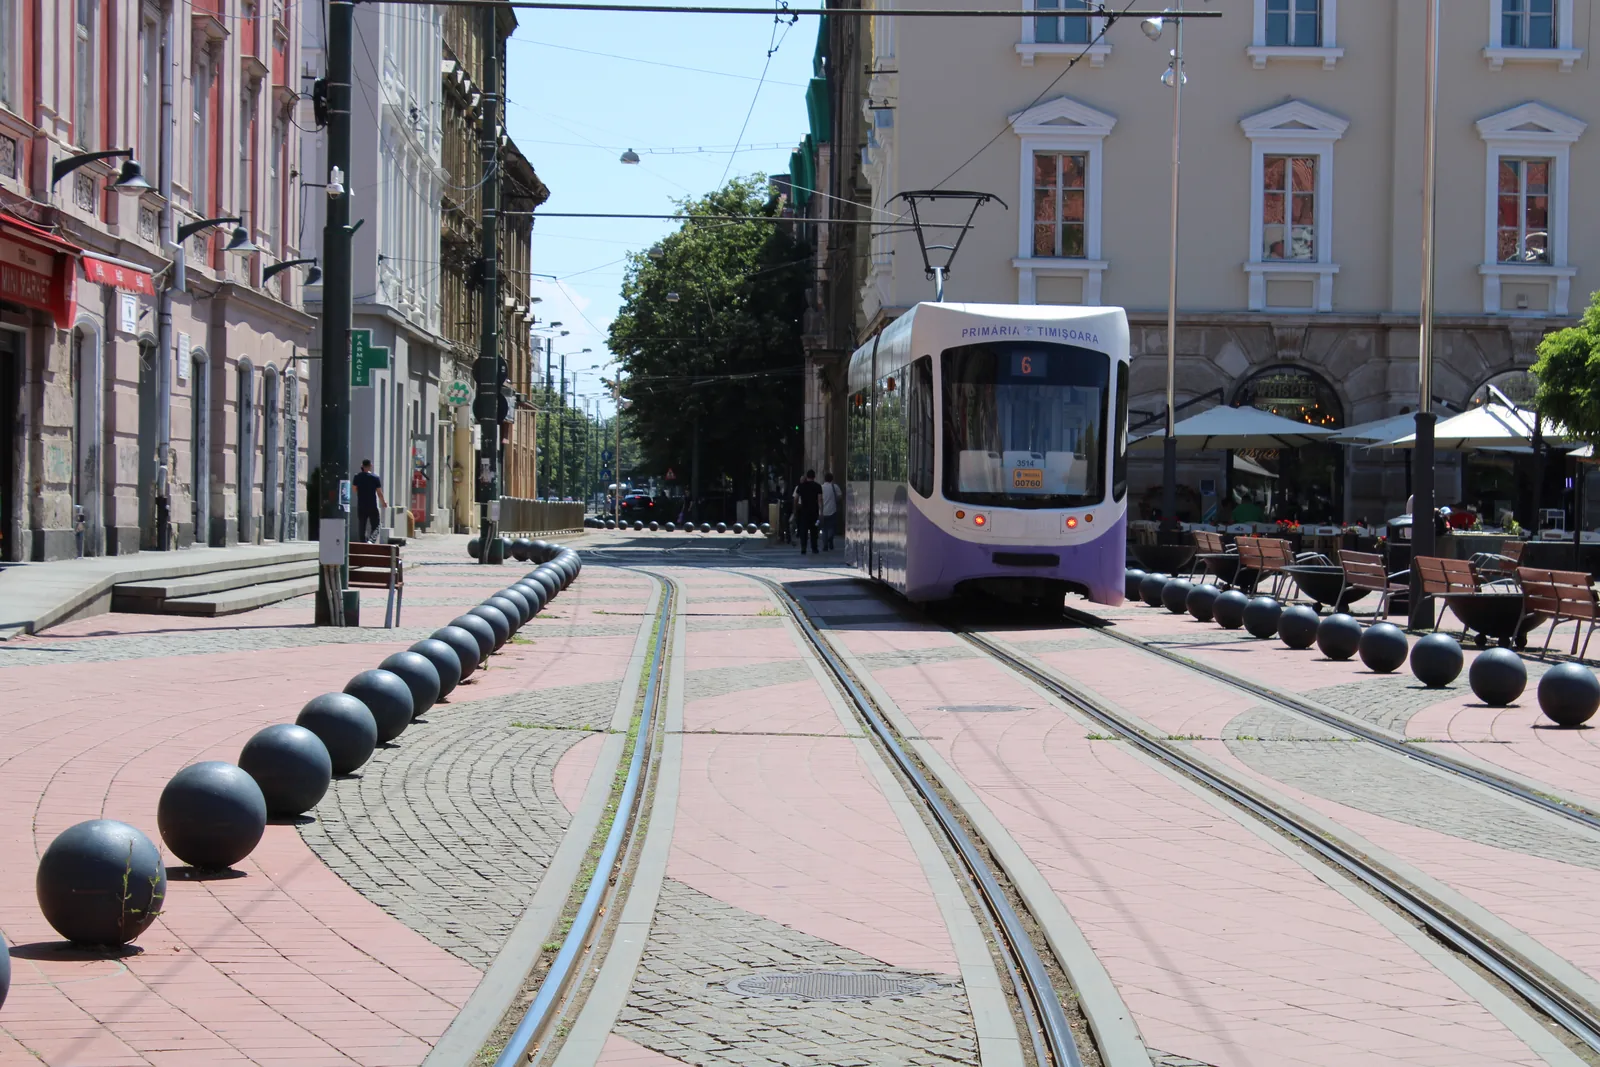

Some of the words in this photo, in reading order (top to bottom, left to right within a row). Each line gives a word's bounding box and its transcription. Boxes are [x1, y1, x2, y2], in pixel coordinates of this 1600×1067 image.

[20, 270, 51, 305] MARKET
[1021, 356, 1032, 374] 6
[1256, 383, 1317, 398] WHISPER
[1016, 459, 1034, 467] 3514
